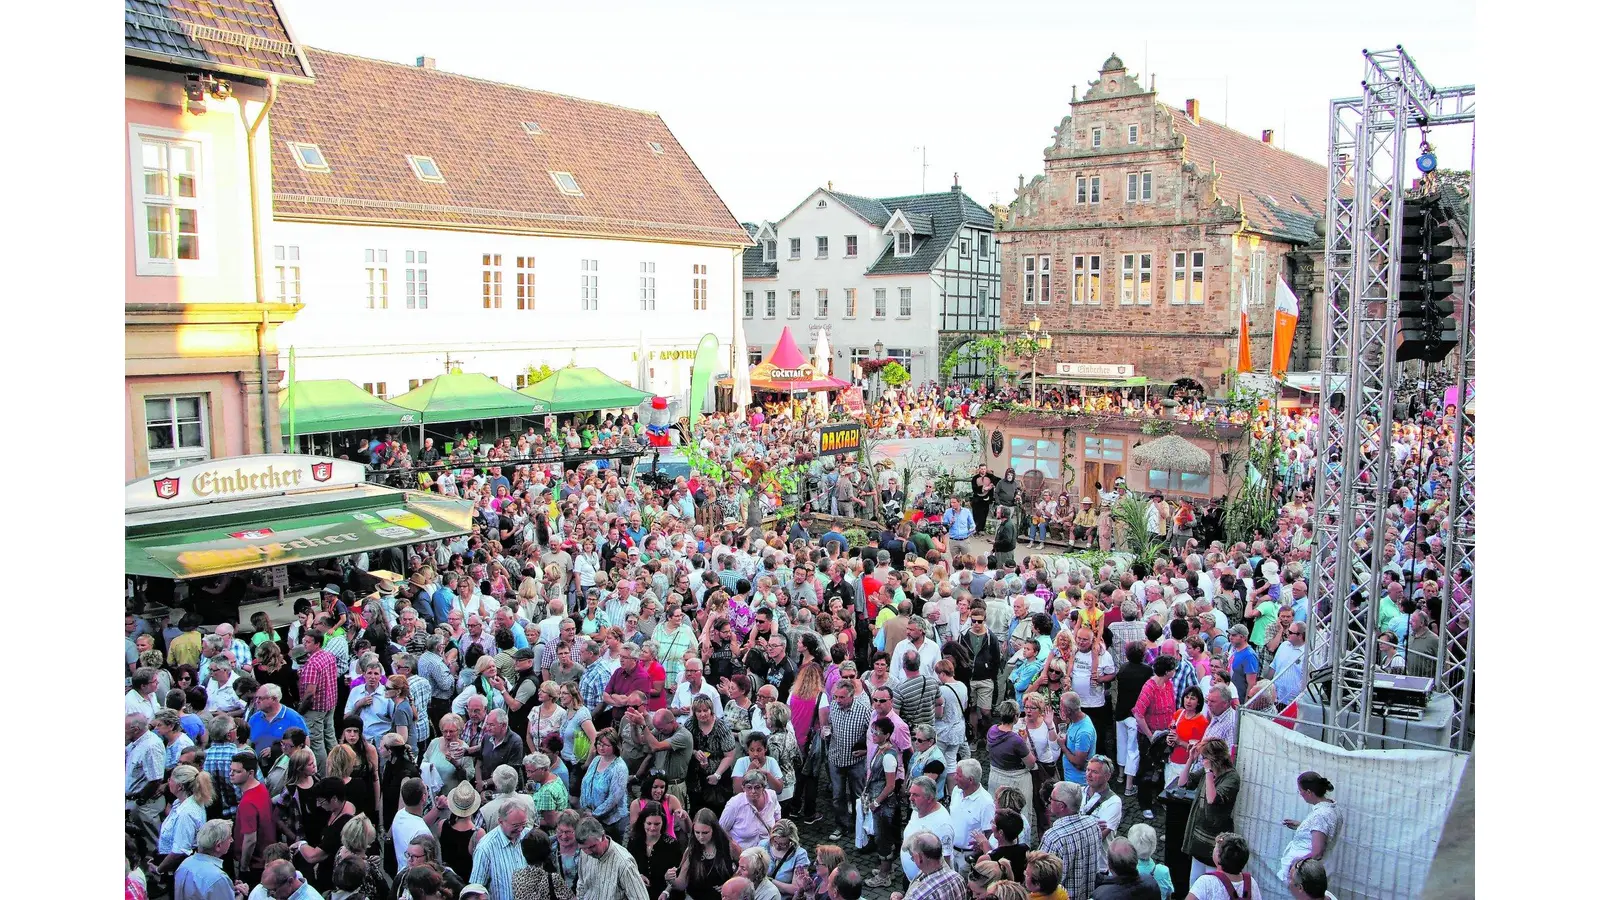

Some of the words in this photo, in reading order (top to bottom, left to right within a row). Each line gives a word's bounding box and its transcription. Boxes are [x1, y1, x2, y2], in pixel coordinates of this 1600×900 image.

[771, 370, 804, 378] COCKTAIL
[1077, 365, 1111, 374] Einbecker
[821, 429, 859, 451] DAKTARI
[191, 465, 303, 497] Einbecker
